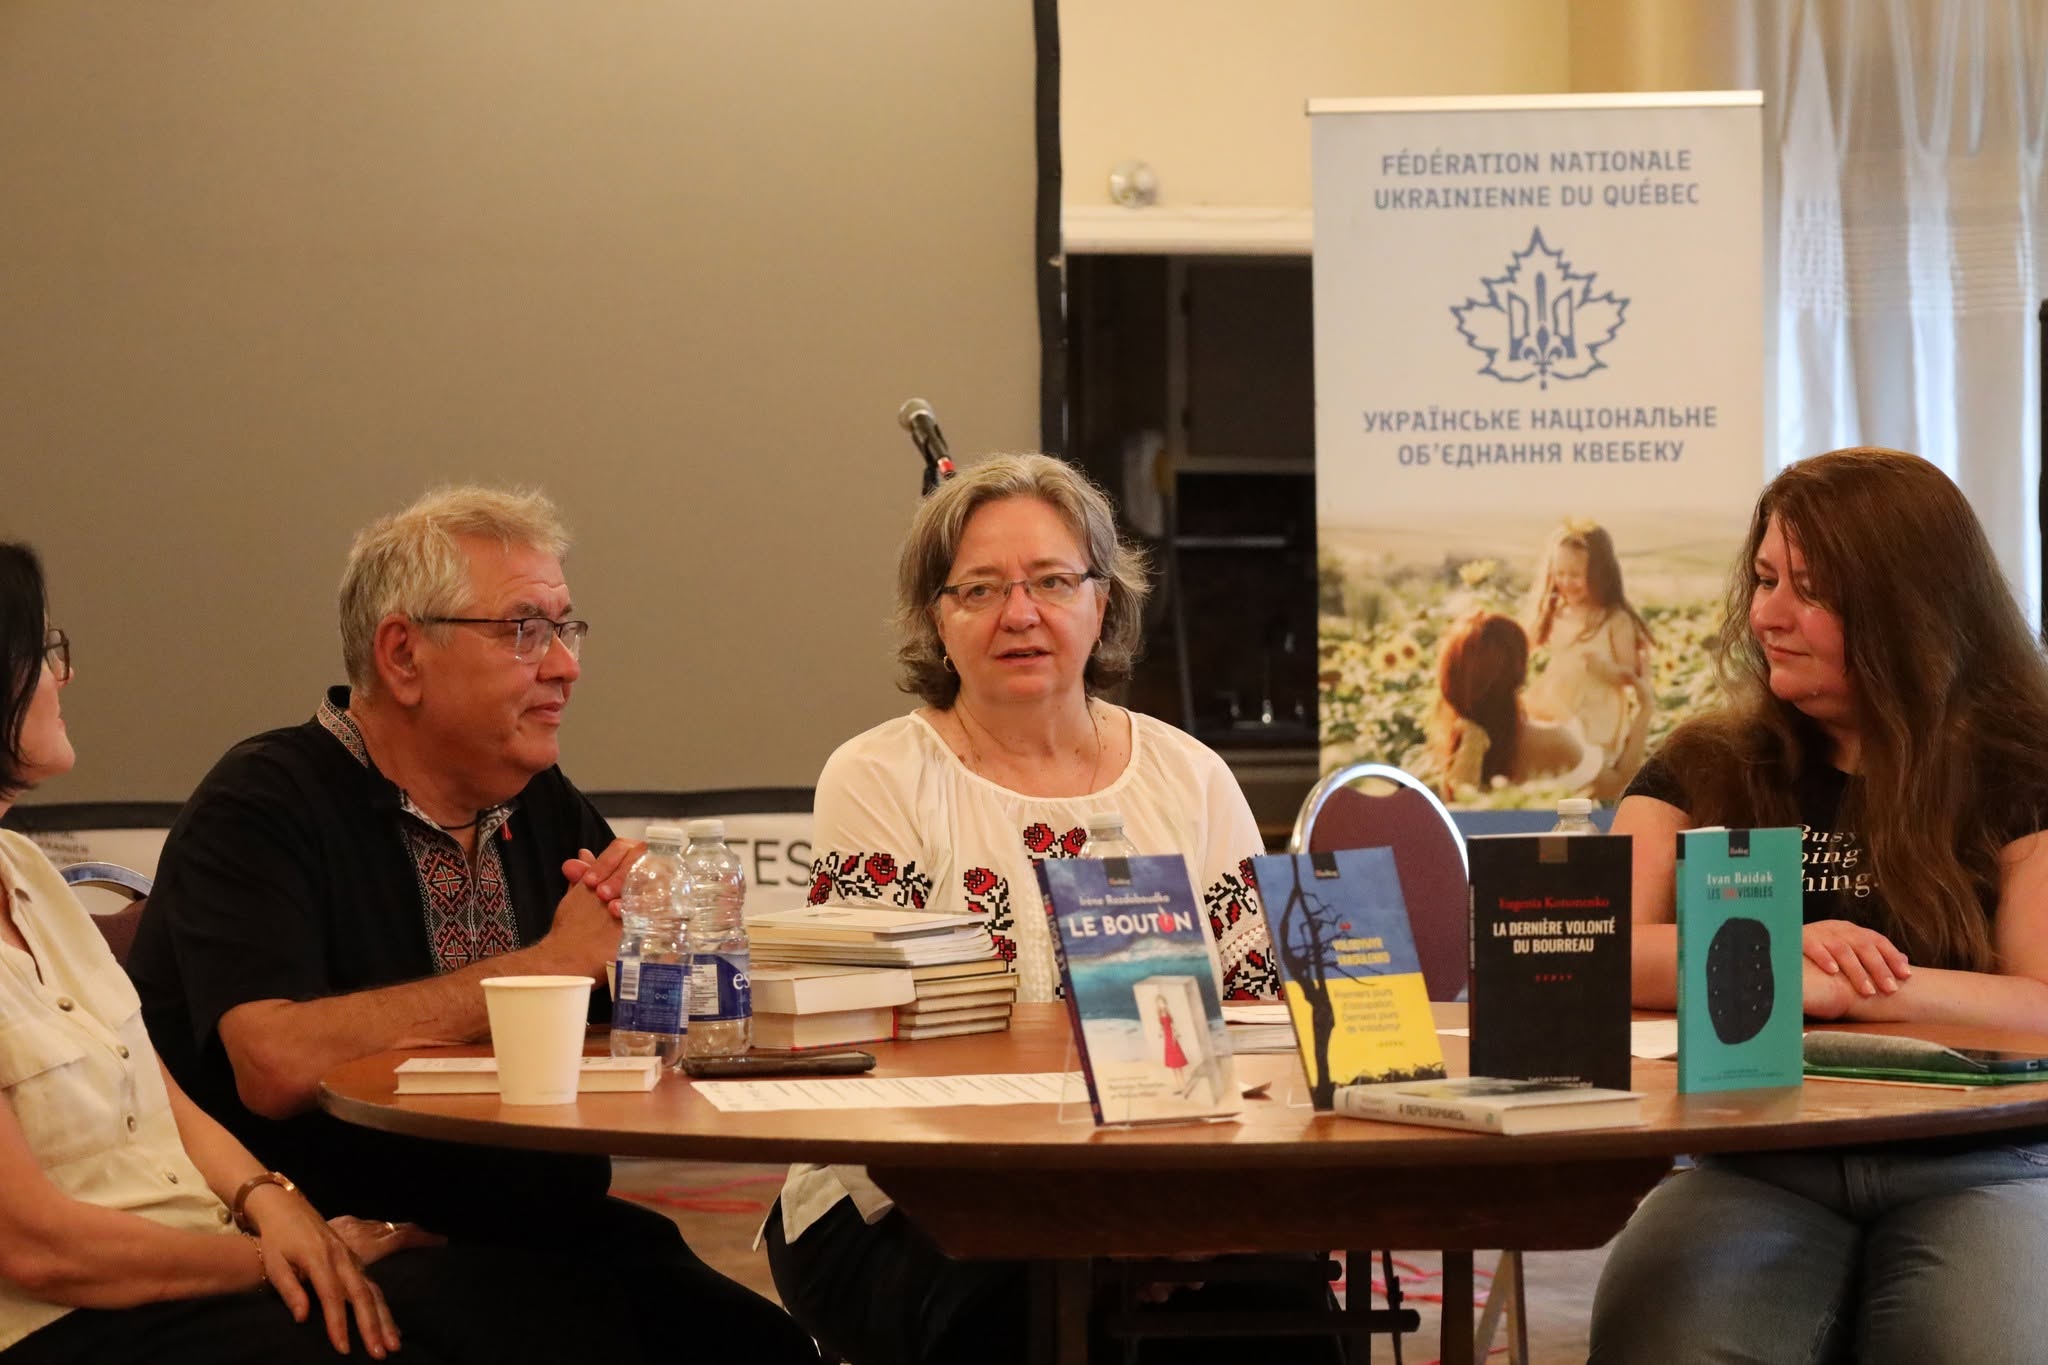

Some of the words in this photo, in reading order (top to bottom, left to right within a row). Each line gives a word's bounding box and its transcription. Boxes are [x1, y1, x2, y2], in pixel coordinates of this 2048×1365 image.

[1382, 149, 1539, 176] FÉDÉRATION
[1550, 150, 1691, 173] NATIONALE
[1374, 186, 1550, 210] UKRAINIENNE
[1561, 186, 1593, 207] DU
[1603, 178, 1699, 208] QUÉBEC
[1364, 406, 1520, 432] УКРАЇНСЬКЕ
[1531, 406, 1717, 433] НАЦІОНАЛЬНЕ
[1573, 441, 1684, 464] КВЕБЕКУ
[1707, 873, 1731, 885] Ivan
[1734, 871, 1774, 884] Baidak
[1068, 915, 1099, 938] LE
[1102, 911, 1193, 936] BOUTON
[1492, 922, 1507, 937] LA
[1509, 917, 1563, 936] DERNIÈRE
[1565, 916, 1616, 935] VOLONTÉ
[1513, 939, 1530, 954] DU
[1532, 938, 1594, 954] BOURREAU
